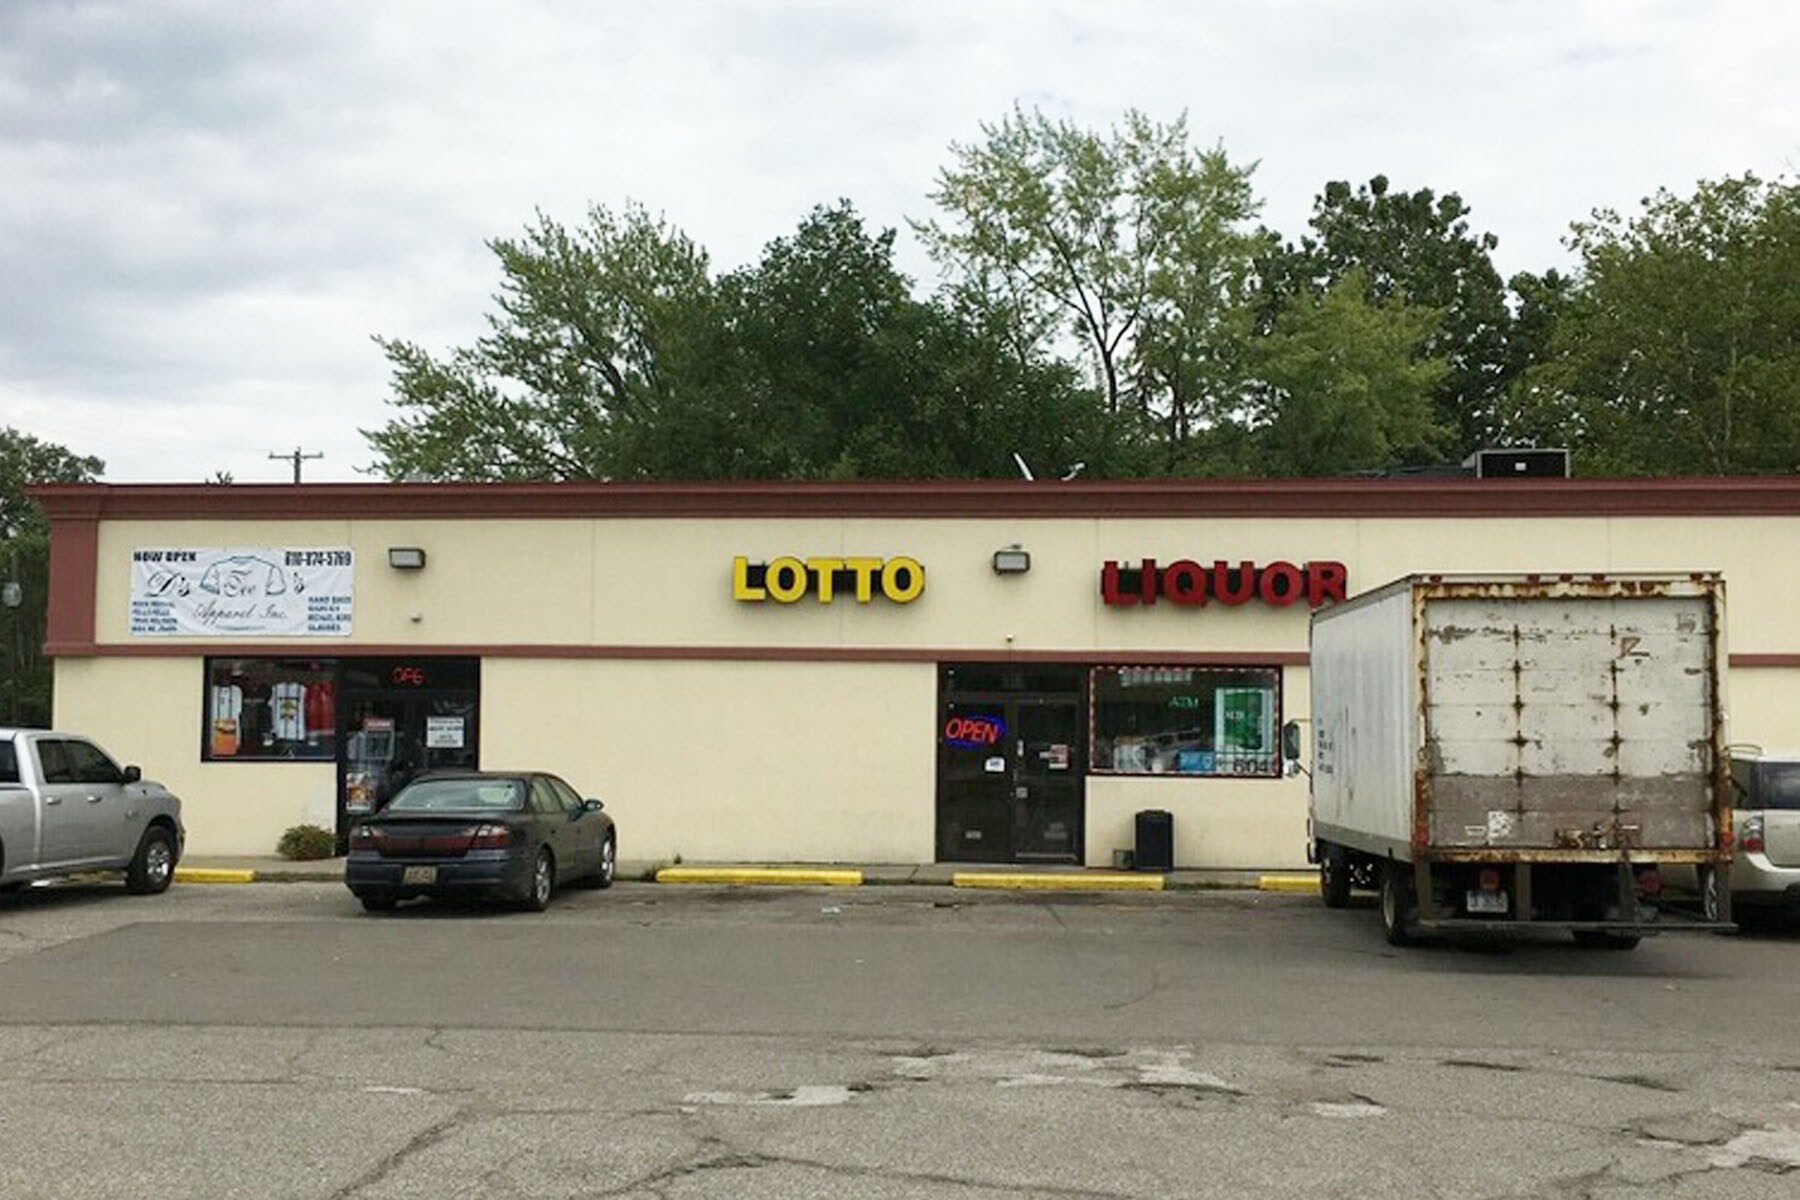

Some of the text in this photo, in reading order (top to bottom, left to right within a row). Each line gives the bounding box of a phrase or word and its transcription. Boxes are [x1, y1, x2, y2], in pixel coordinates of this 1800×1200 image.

[133, 551, 197, 562] NOW OPEN
[733, 556, 924, 604] LOTTO
[1102, 558, 1347, 609] LIQUOR
[945, 718, 998, 744] OPEN
